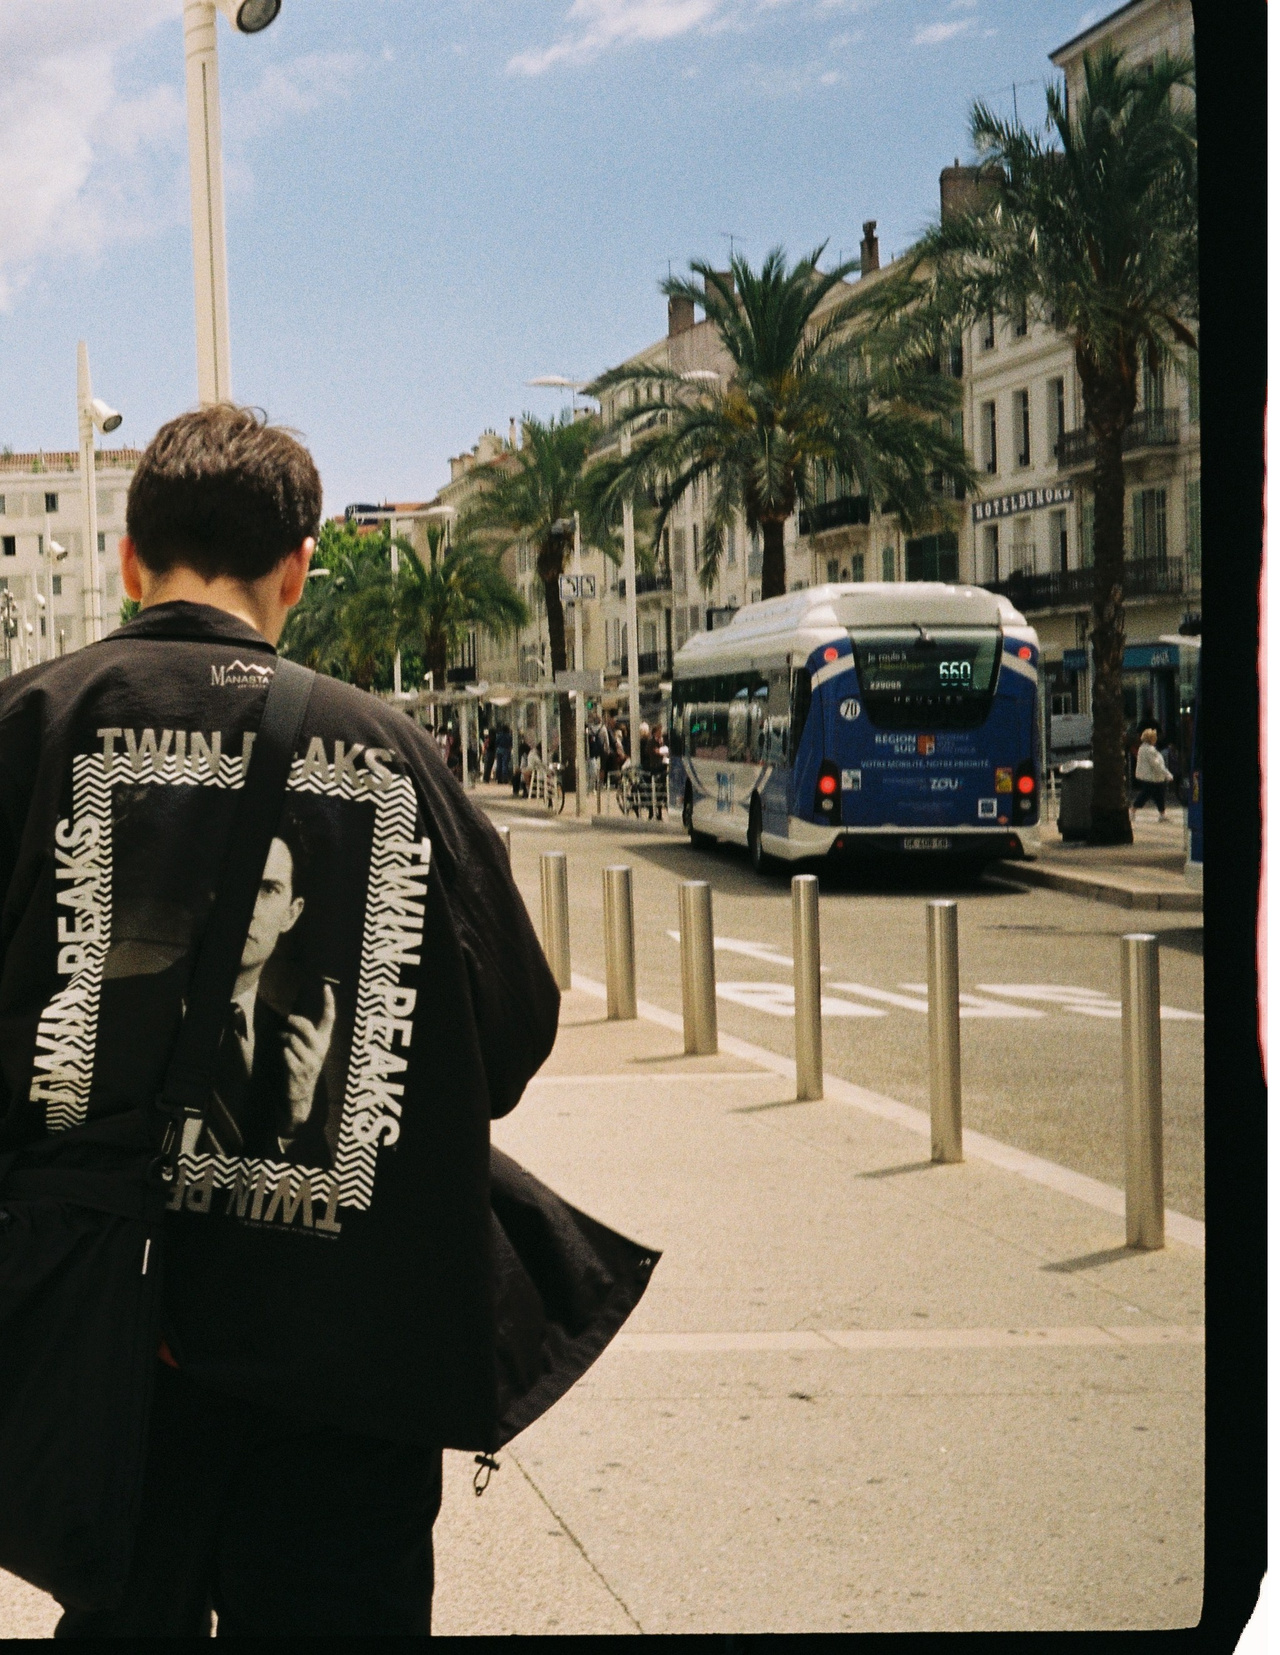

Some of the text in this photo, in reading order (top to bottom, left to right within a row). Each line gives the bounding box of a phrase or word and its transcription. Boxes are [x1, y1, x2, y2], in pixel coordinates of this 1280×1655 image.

[939, 661, 971, 687] 660
[97, 727, 222, 776] TWIN
[894, 744, 916, 754] SUD
[29, 817, 102, 1105] TWIN PEAKS
[352, 837, 431, 1147] TWIN PEAKS
[226, 1170, 342, 1233] TWIN
